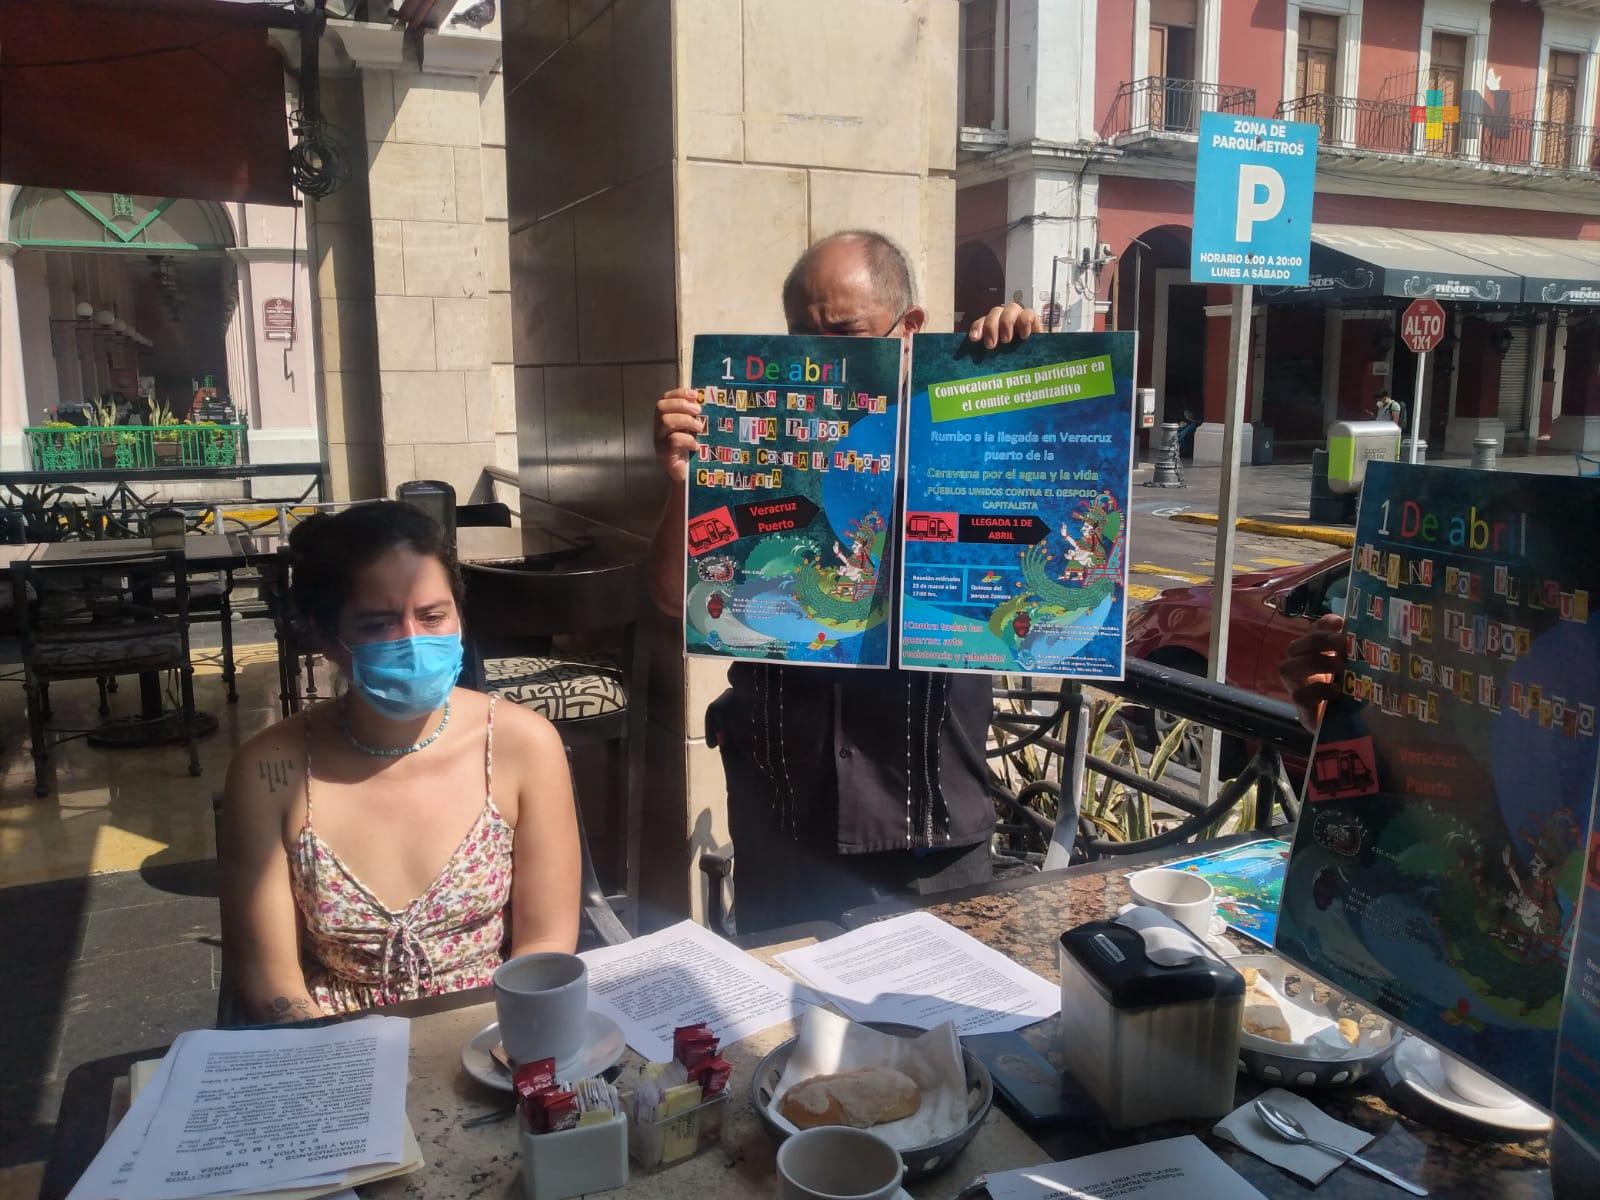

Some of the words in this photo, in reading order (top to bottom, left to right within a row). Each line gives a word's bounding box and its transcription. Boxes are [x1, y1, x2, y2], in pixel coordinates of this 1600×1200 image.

[1233, 120, 1267, 136] ZONA
[1269, 124, 1287, 138] DE
[1212, 135, 1304, 156] PARQUÍMETROS
[1235, 164, 1286, 242] P
[1200, 252, 1243, 263] HORARIO
[1266, 256, 1275, 266] A
[1275, 256, 1302, 266] 20:00
[1211, 267, 1241, 277] LUNES
[1242, 268, 1250, 278] A
[1251, 267, 1290, 279] SÁBADO
[1405, 315, 1440, 336] ALTO
[1412, 336, 1431, 350] 1X1
[721, 357, 735, 380] 1
[745, 355, 780, 381] De
[788, 356, 847, 383] abril
[934, 378, 1004, 400] Convocatoria
[1006, 374, 1032, 390] para
[1034, 363, 1088, 385] participar
[1091, 361, 1105, 373] en
[962, 398, 972, 413] el
[974, 393, 1011, 410] comité
[1013, 382, 1081, 405] organizativo
[931, 431, 972, 443] Rumbo
[974, 434, 982, 443] a
[984, 431, 995, 443] la
[997, 431, 1040, 446] llegada
[1041, 434, 1057, 444] en
[1059, 432, 1112, 444] Veracruz
[984, 450, 1024, 463] puerto
[1025, 449, 1041, 461] de
[1043, 449, 1055, 461] la
[927, 468, 980, 479] Caravana
[982, 471, 1003, 483] por
[1005, 468, 1017, 480] el
[1019, 471, 1049, 483] agua
[1050, 471, 1058, 483] y
[1060, 469, 1071, 481] la
[1072, 469, 1099, 481] vida
[927, 486, 966, 496] PUEBLOS
[968, 487, 1004, 497] UNIDOS
[1005, 488, 1042, 497] CONTRA
[1044, 488, 1056, 497] EL
[1056, 488, 1097, 498] DESPOJO
[749, 501, 798, 517] Veracruz
[982, 501, 1038, 511] CAPITALISTA
[758, 519, 795, 533] Puerto
[971, 518, 1011, 528] LLEGADA
[1013, 518, 1020, 528] 1
[1021, 518, 1033, 528] DE
[1378, 500, 1391, 536] 1
[1401, 501, 1439, 542] De
[1449, 506, 1527, 556] abril
[988, 531, 1015, 540] ABRIL
[1400, 748, 1457, 768] Veracruz
[1406, 776, 1451, 796] Puerto
